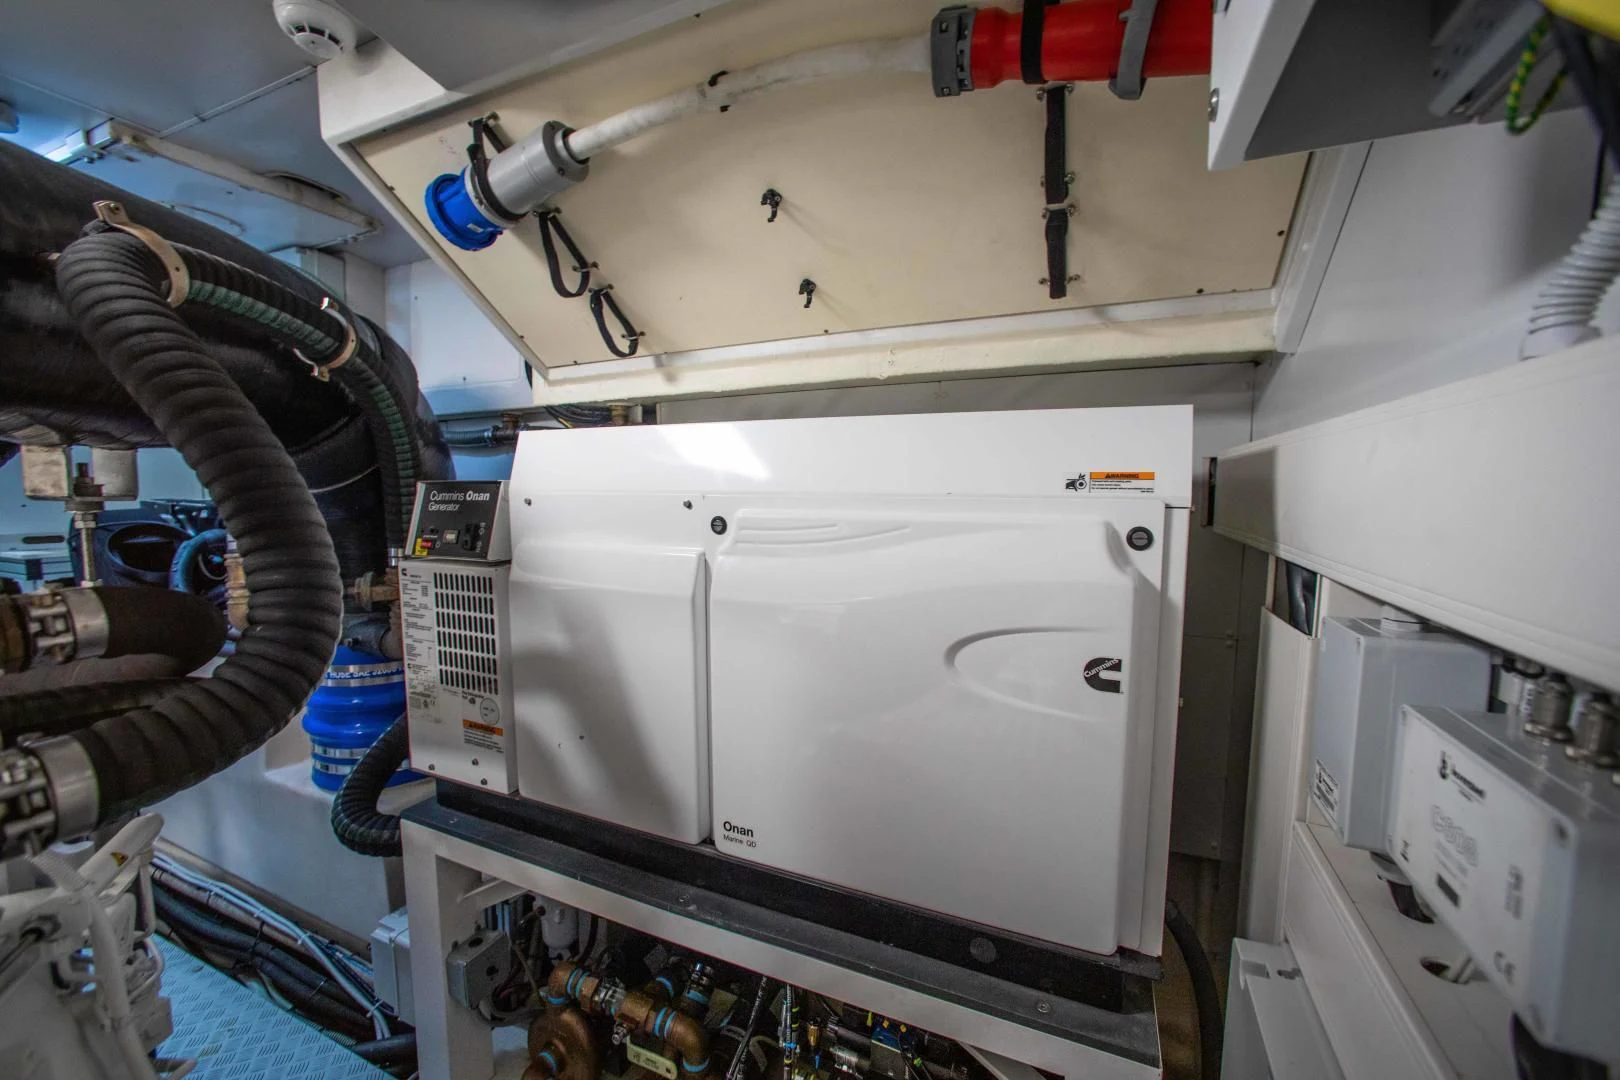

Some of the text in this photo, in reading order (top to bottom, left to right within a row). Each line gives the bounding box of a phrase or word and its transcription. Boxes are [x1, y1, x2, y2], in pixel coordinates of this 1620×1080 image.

[430, 490, 490, 501] Cummins Onan
[429, 502, 460, 511] Generator
[1084, 659, 1119, 678] Cummins
[723, 821, 754, 838] Onan
[723, 834, 744, 845] Marine
